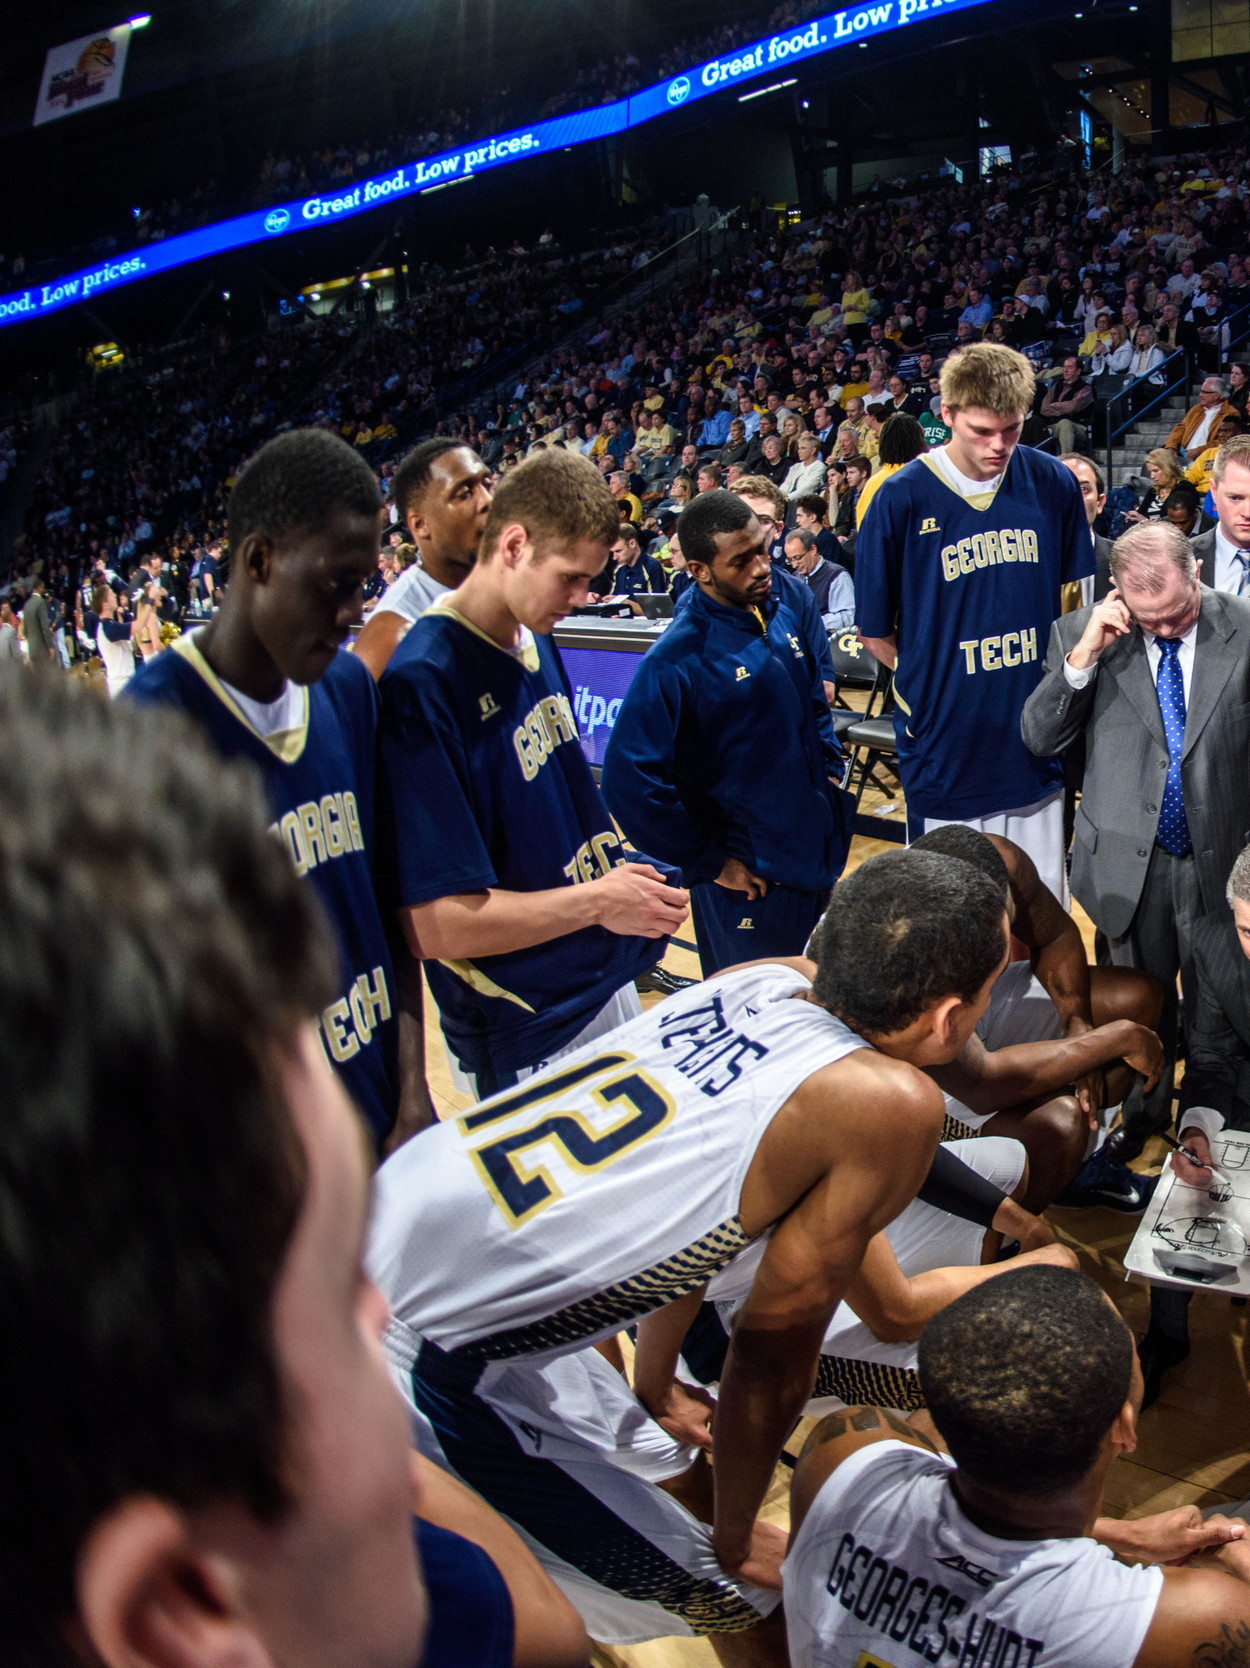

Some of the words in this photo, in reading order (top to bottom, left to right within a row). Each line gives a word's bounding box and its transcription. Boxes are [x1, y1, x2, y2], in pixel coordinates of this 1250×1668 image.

[701, 46, 763, 86] Great
[767, 22, 828, 62] food.
[833, 3, 893, 39] Low
[301, 189, 361, 219] Great
[363, 169, 411, 202] food.
[415, 161, 460, 184] Low
[462, 132, 540, 173] prices.
[0, 292, 36, 317] ood.
[41, 286, 81, 306] Low
[82, 256, 147, 299] prices.
[941, 528, 1039, 582] GEORGIA
[838, 633, 863, 657] GT
[959, 627, 1038, 675] TECH
[278, 791, 365, 876] ORGIA
[563, 831, 627, 885] TEC
[321, 965, 392, 1062] ECH
[455, 1050, 677, 1231] 12
[934, 1554, 998, 1588] ACC
